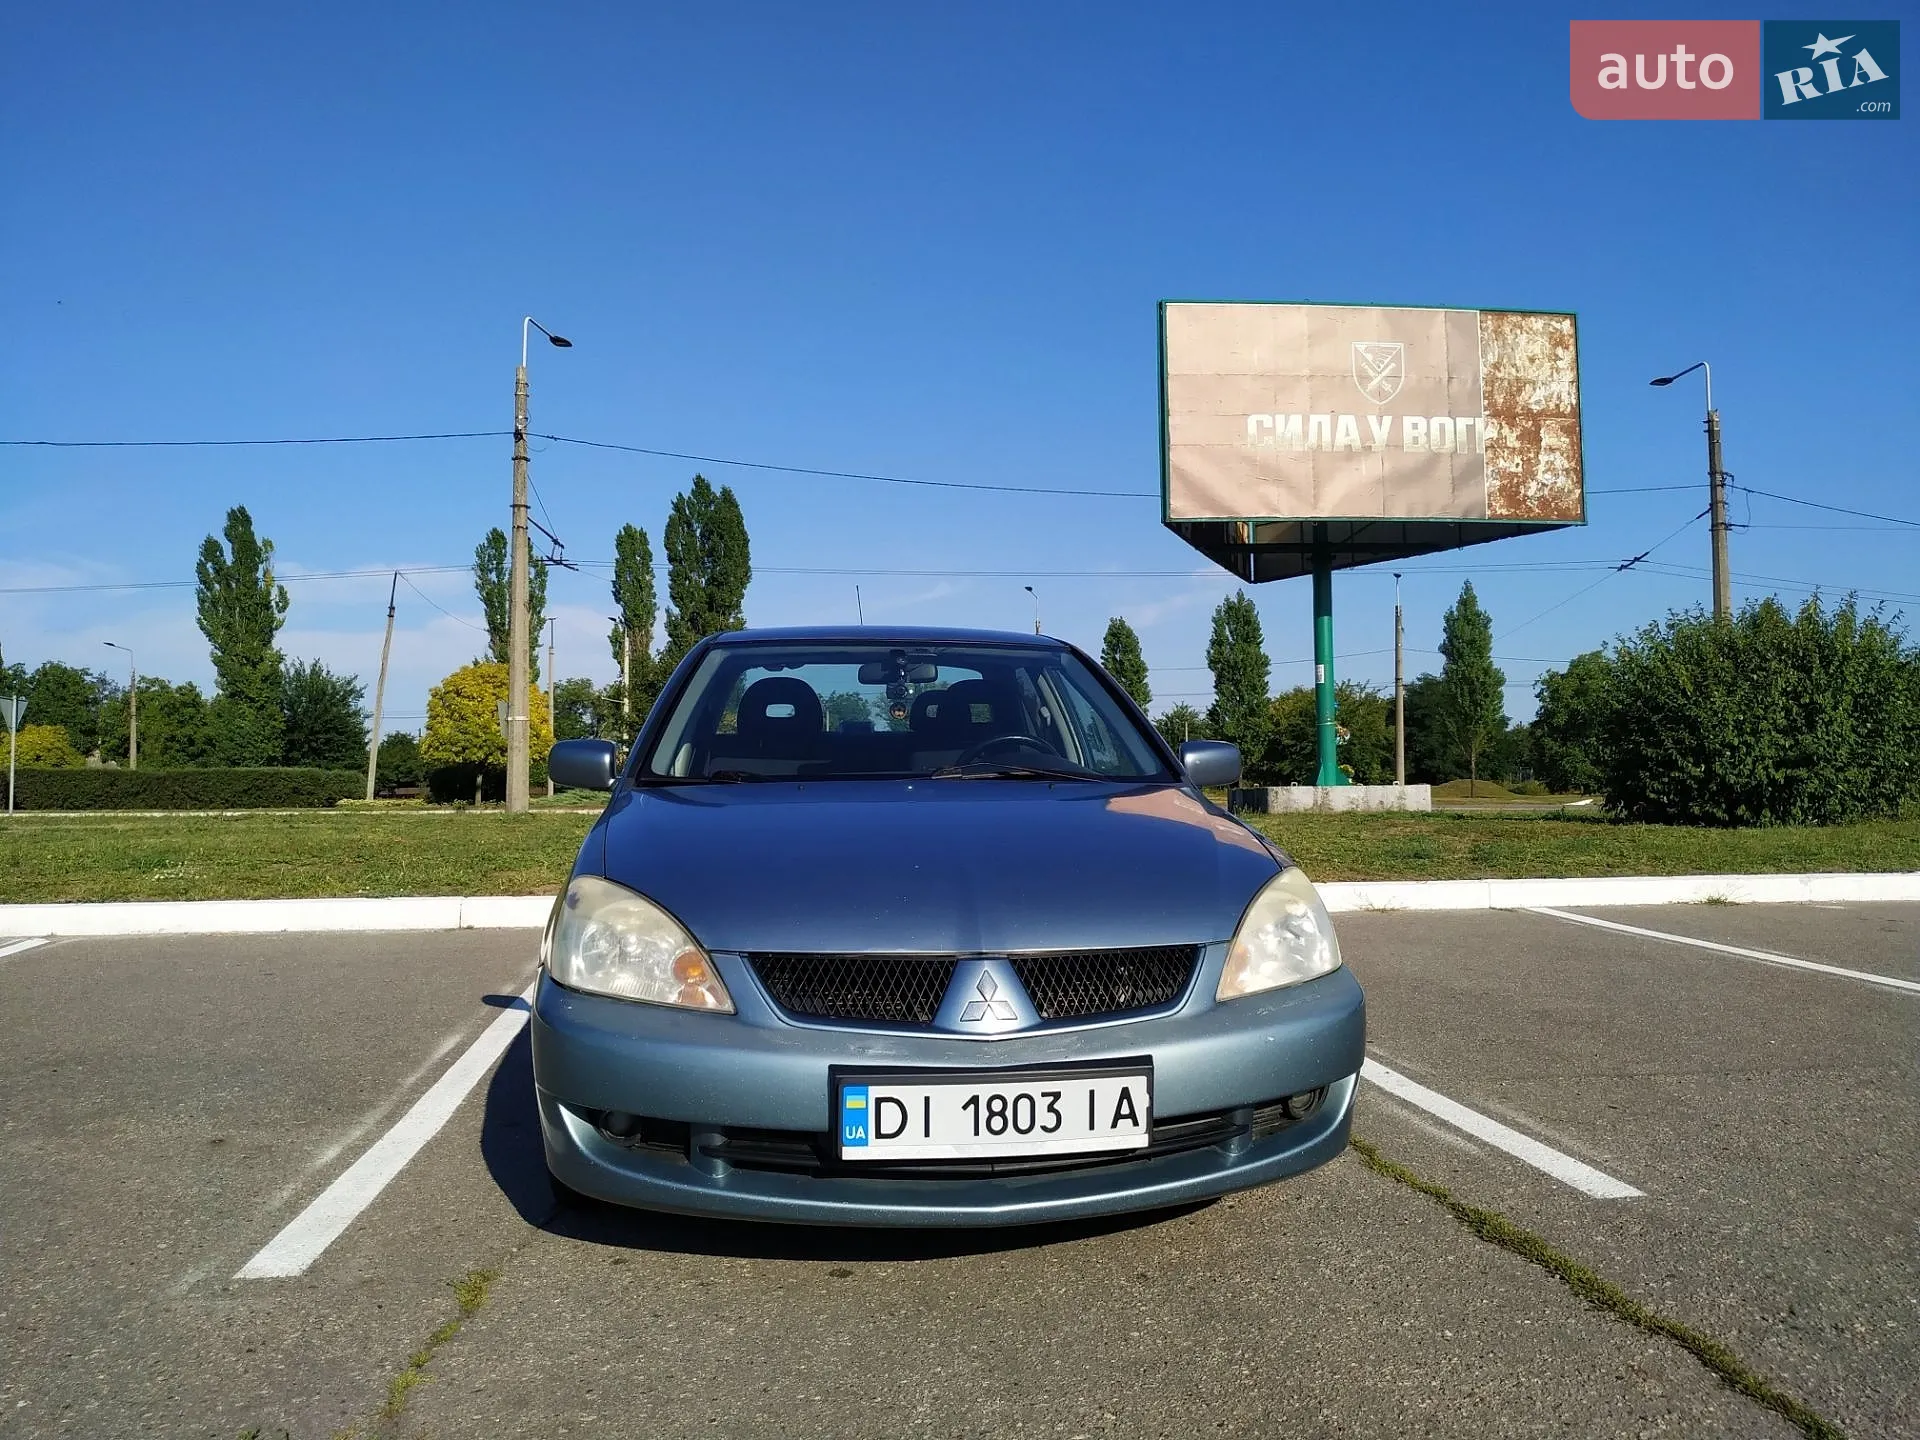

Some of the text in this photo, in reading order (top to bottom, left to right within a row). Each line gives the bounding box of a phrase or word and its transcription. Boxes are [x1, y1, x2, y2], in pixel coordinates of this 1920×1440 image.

[1247, 413, 1362, 452] СИЛА
[1365, 415, 1393, 453] У
[845, 1125, 866, 1140] UA
[874, 1086, 1140, 1140] DI 1803 IA
